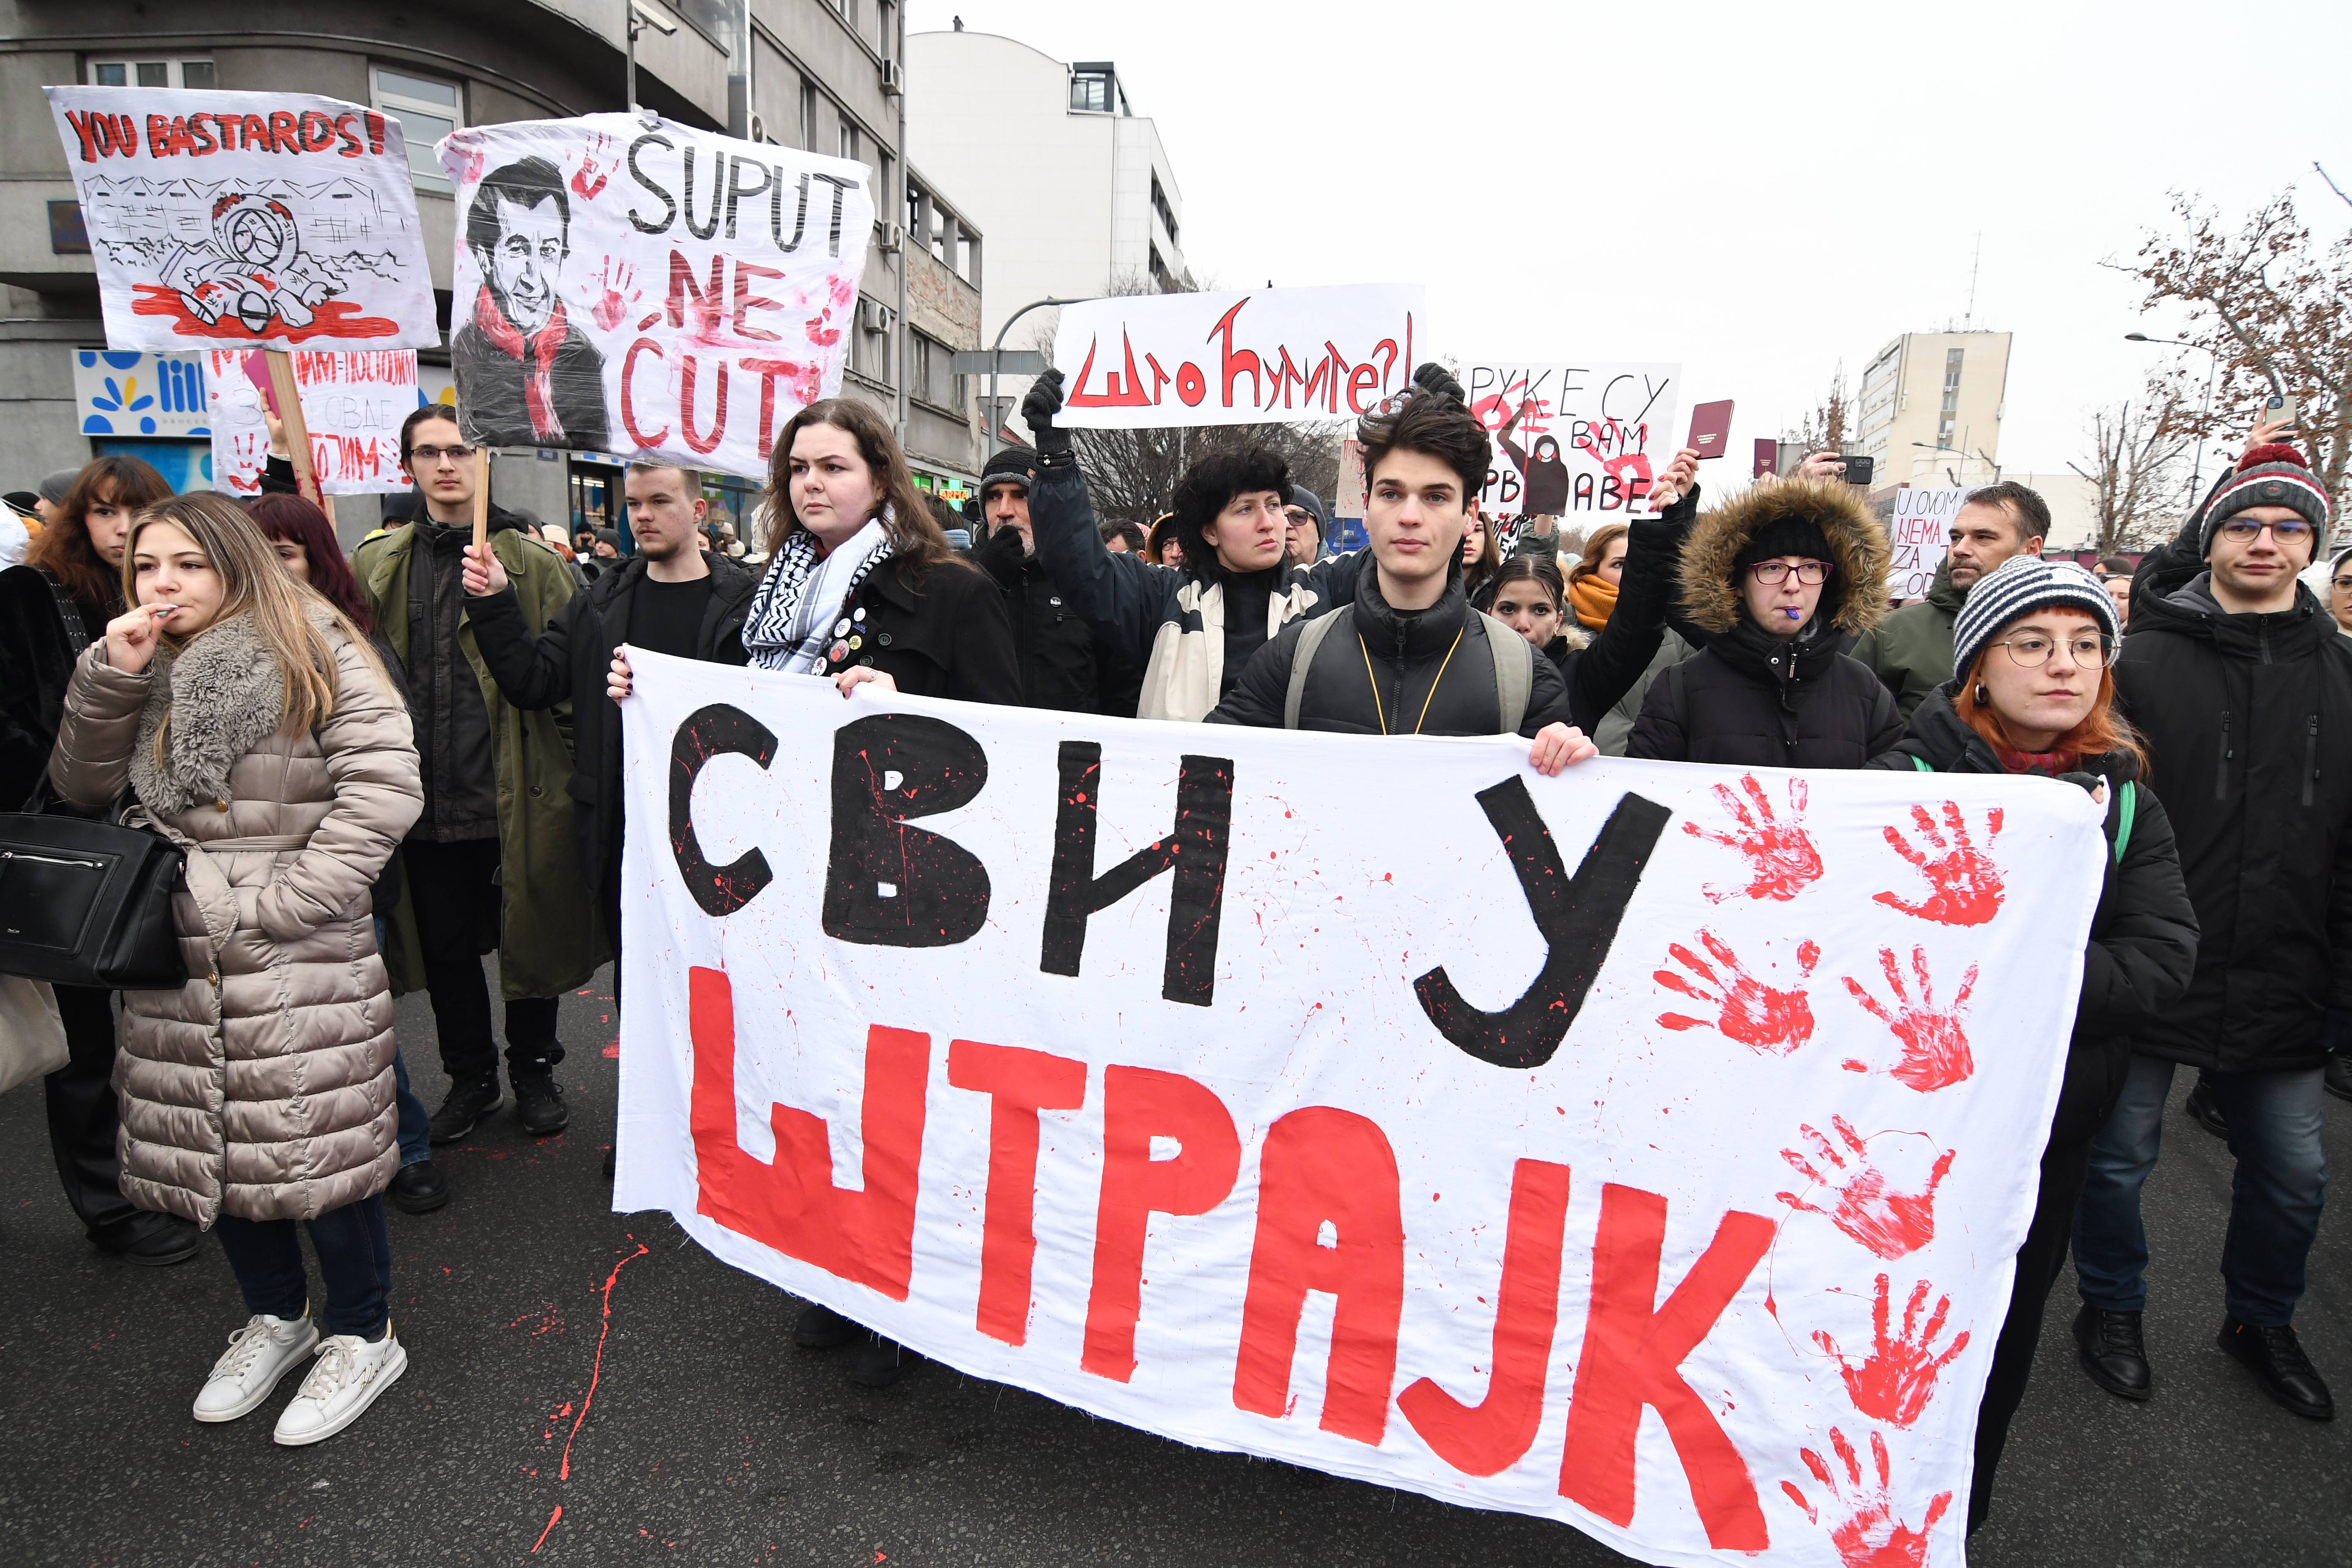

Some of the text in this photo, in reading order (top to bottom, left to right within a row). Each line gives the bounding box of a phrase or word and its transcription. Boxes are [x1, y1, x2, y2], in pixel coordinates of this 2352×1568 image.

[65, 110, 386, 163] YOU BASTARDS!
[627, 119, 859, 258] ŠUPUT
[667, 249, 786, 341] NE
[325, 396, 393, 430] ОВДЕ
[1571, 421, 1645, 457] ВАМ
[1897, 490, 1958, 515] U OVOM
[1897, 518, 1940, 544] NEMA
[1892, 545, 1920, 569] ZA
[668, 702, 1674, 1069] СВИ У
[689, 966, 1778, 1551] ШТРАЈК
